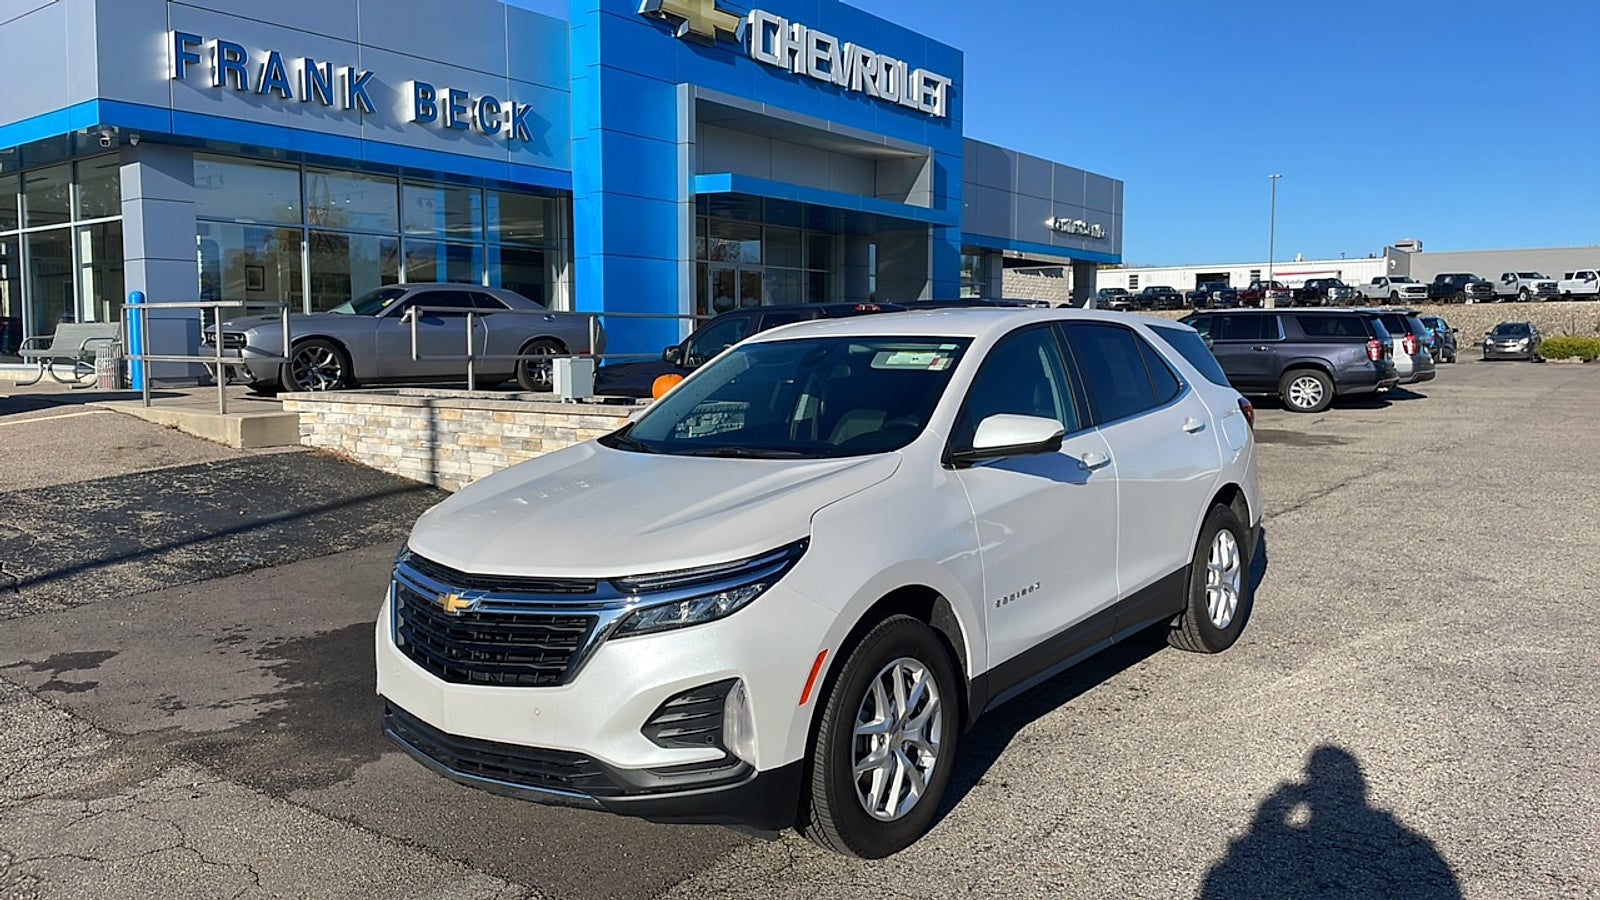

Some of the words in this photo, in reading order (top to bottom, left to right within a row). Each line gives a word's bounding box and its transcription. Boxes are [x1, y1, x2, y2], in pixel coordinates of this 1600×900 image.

[168, 30, 377, 113] FRANK
[406, 80, 534, 142] BECK
[748, 8, 952, 117] CHEVROLET
